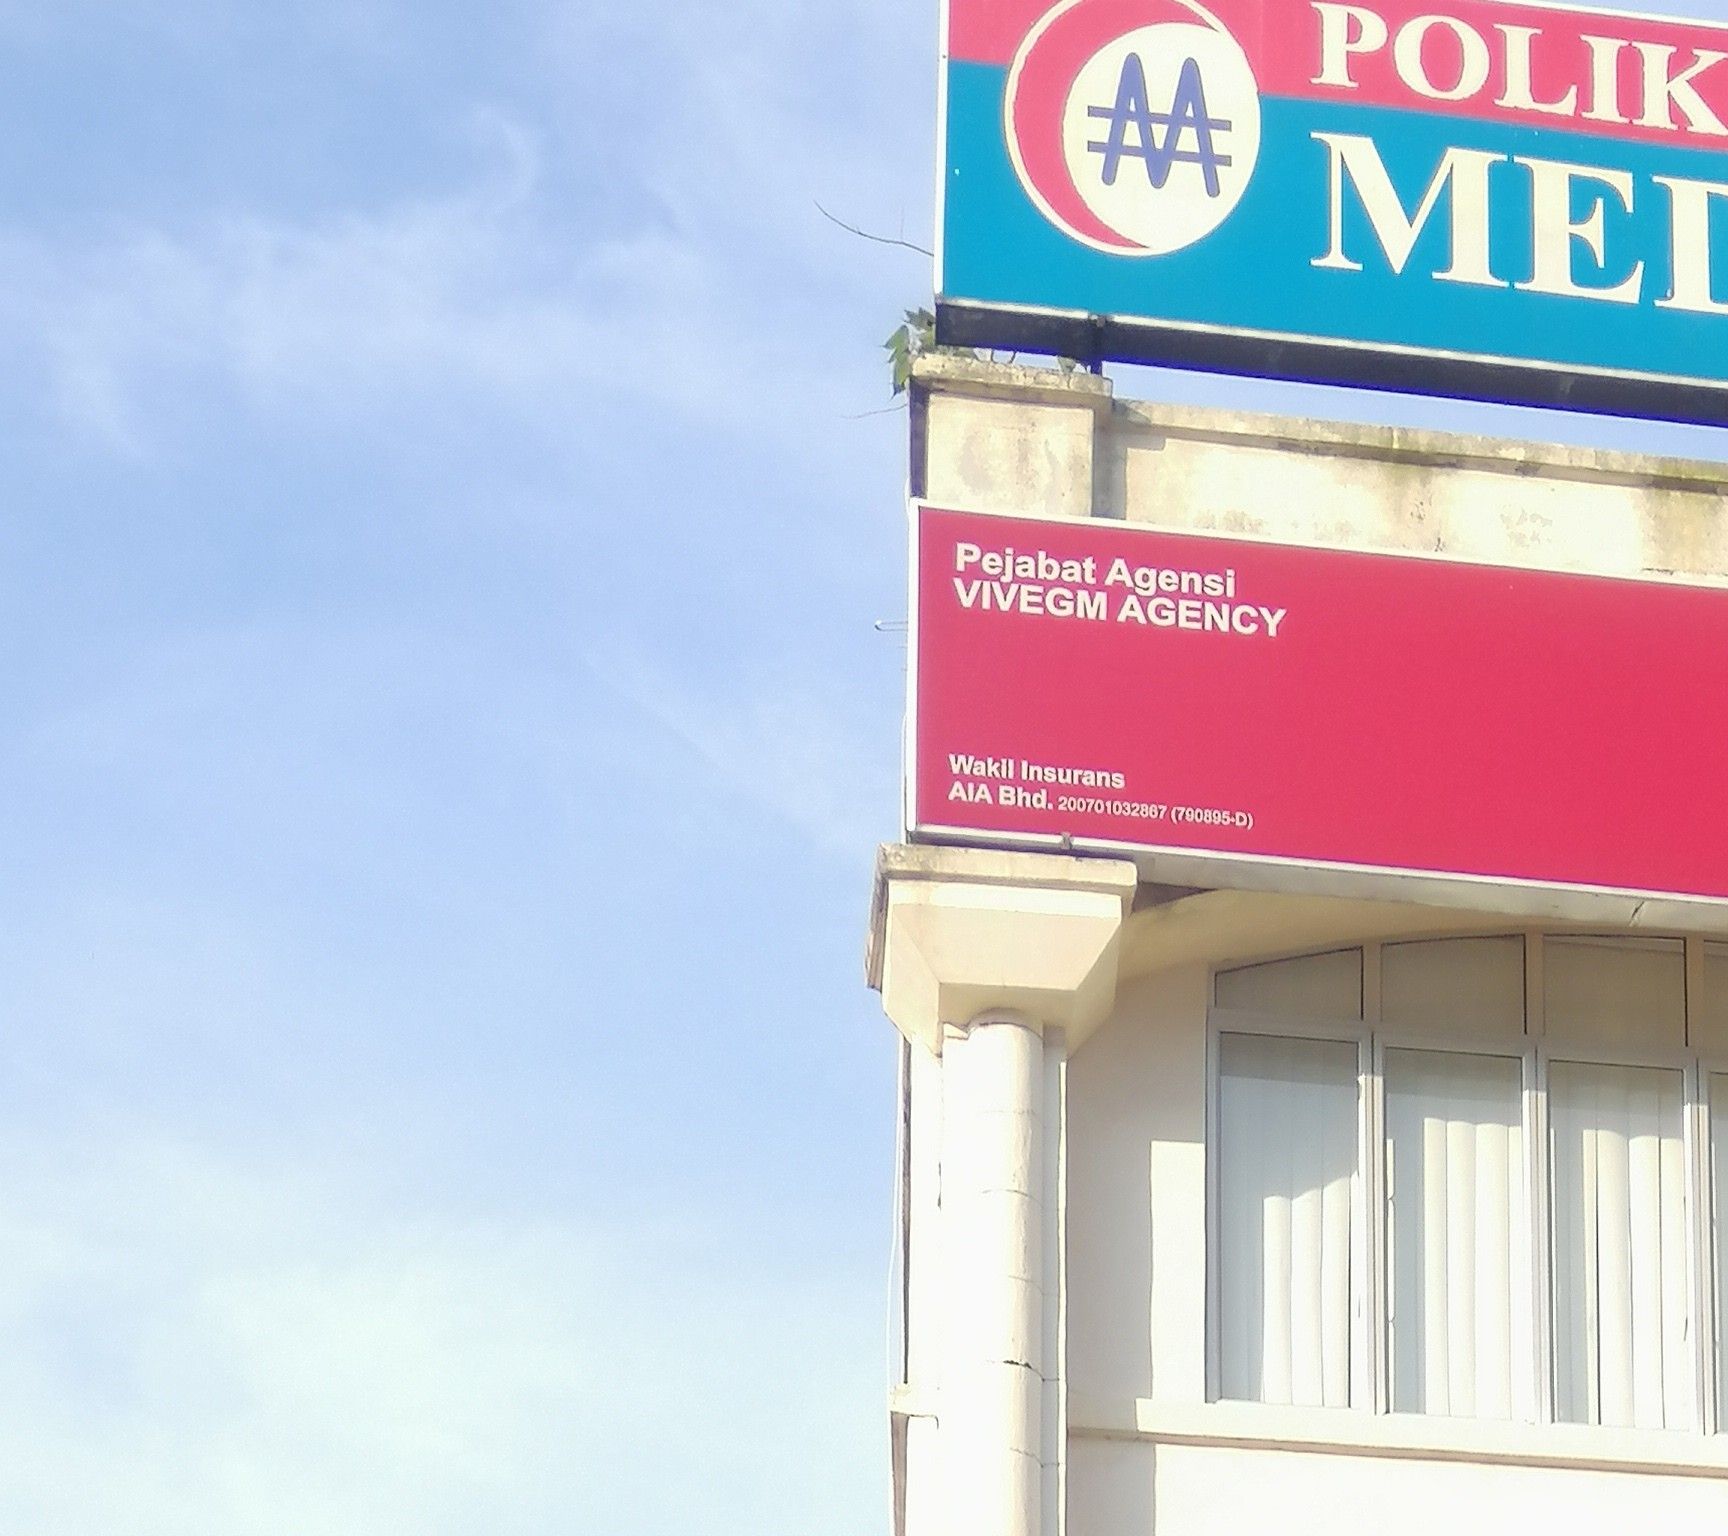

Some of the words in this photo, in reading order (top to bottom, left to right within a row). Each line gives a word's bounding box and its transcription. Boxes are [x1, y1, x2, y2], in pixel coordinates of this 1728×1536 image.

[954, 541, 1097, 585] Pejabat
[1103, 557, 1237, 598] Agensi
[953, 576, 1108, 622] VIVEGM
[1115, 593, 1287, 637] AGENCY
[948, 753, 1014, 780] Wakil
[1020, 759, 1126, 790] Insurans
[948, 780, 993, 805] AIA
[998, 783, 1054, 810] Bhd.
